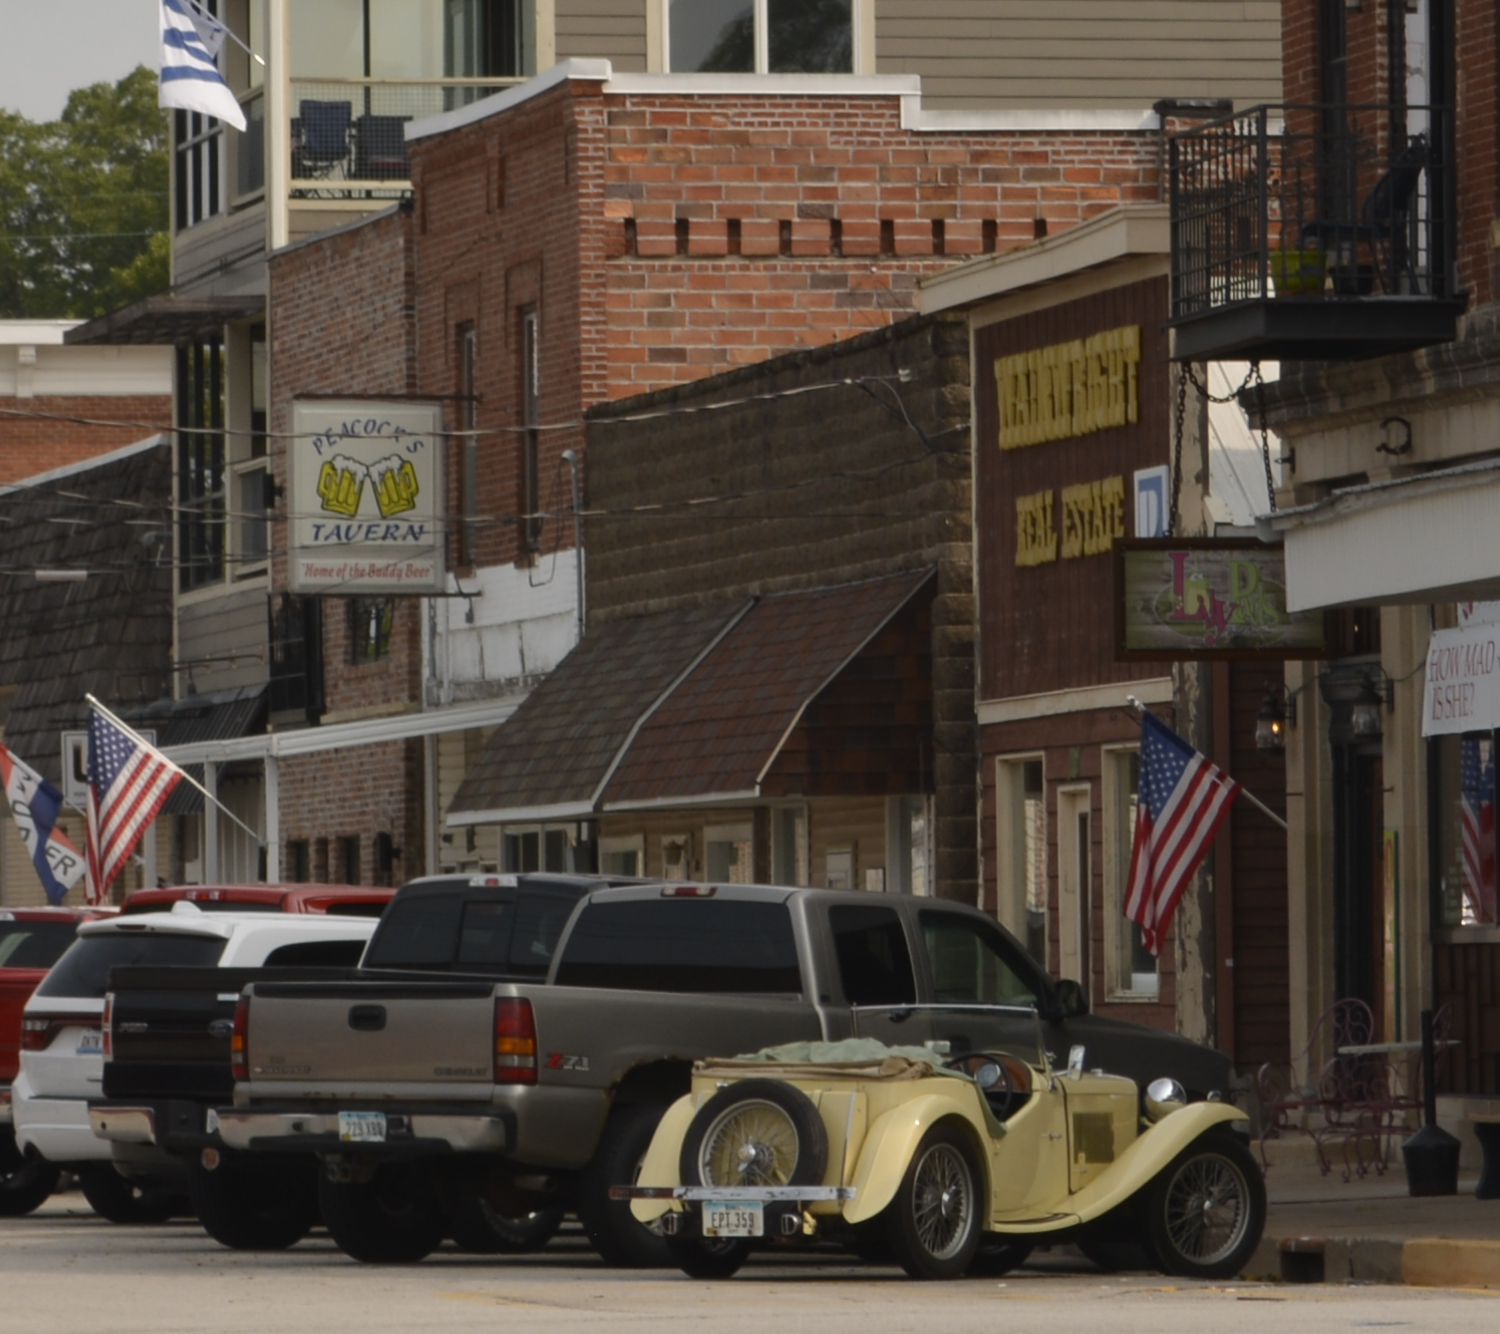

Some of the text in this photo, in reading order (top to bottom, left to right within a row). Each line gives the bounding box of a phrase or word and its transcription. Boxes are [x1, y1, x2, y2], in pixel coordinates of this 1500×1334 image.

[312, 523, 425, 542] TAVERN
[1015, 475, 1125, 567] REAL ESTATE
[1428, 640, 1496, 683] HOW MAD
[1432, 682, 1476, 721] IS SHE?
[734, 1211, 755, 1229] 359
